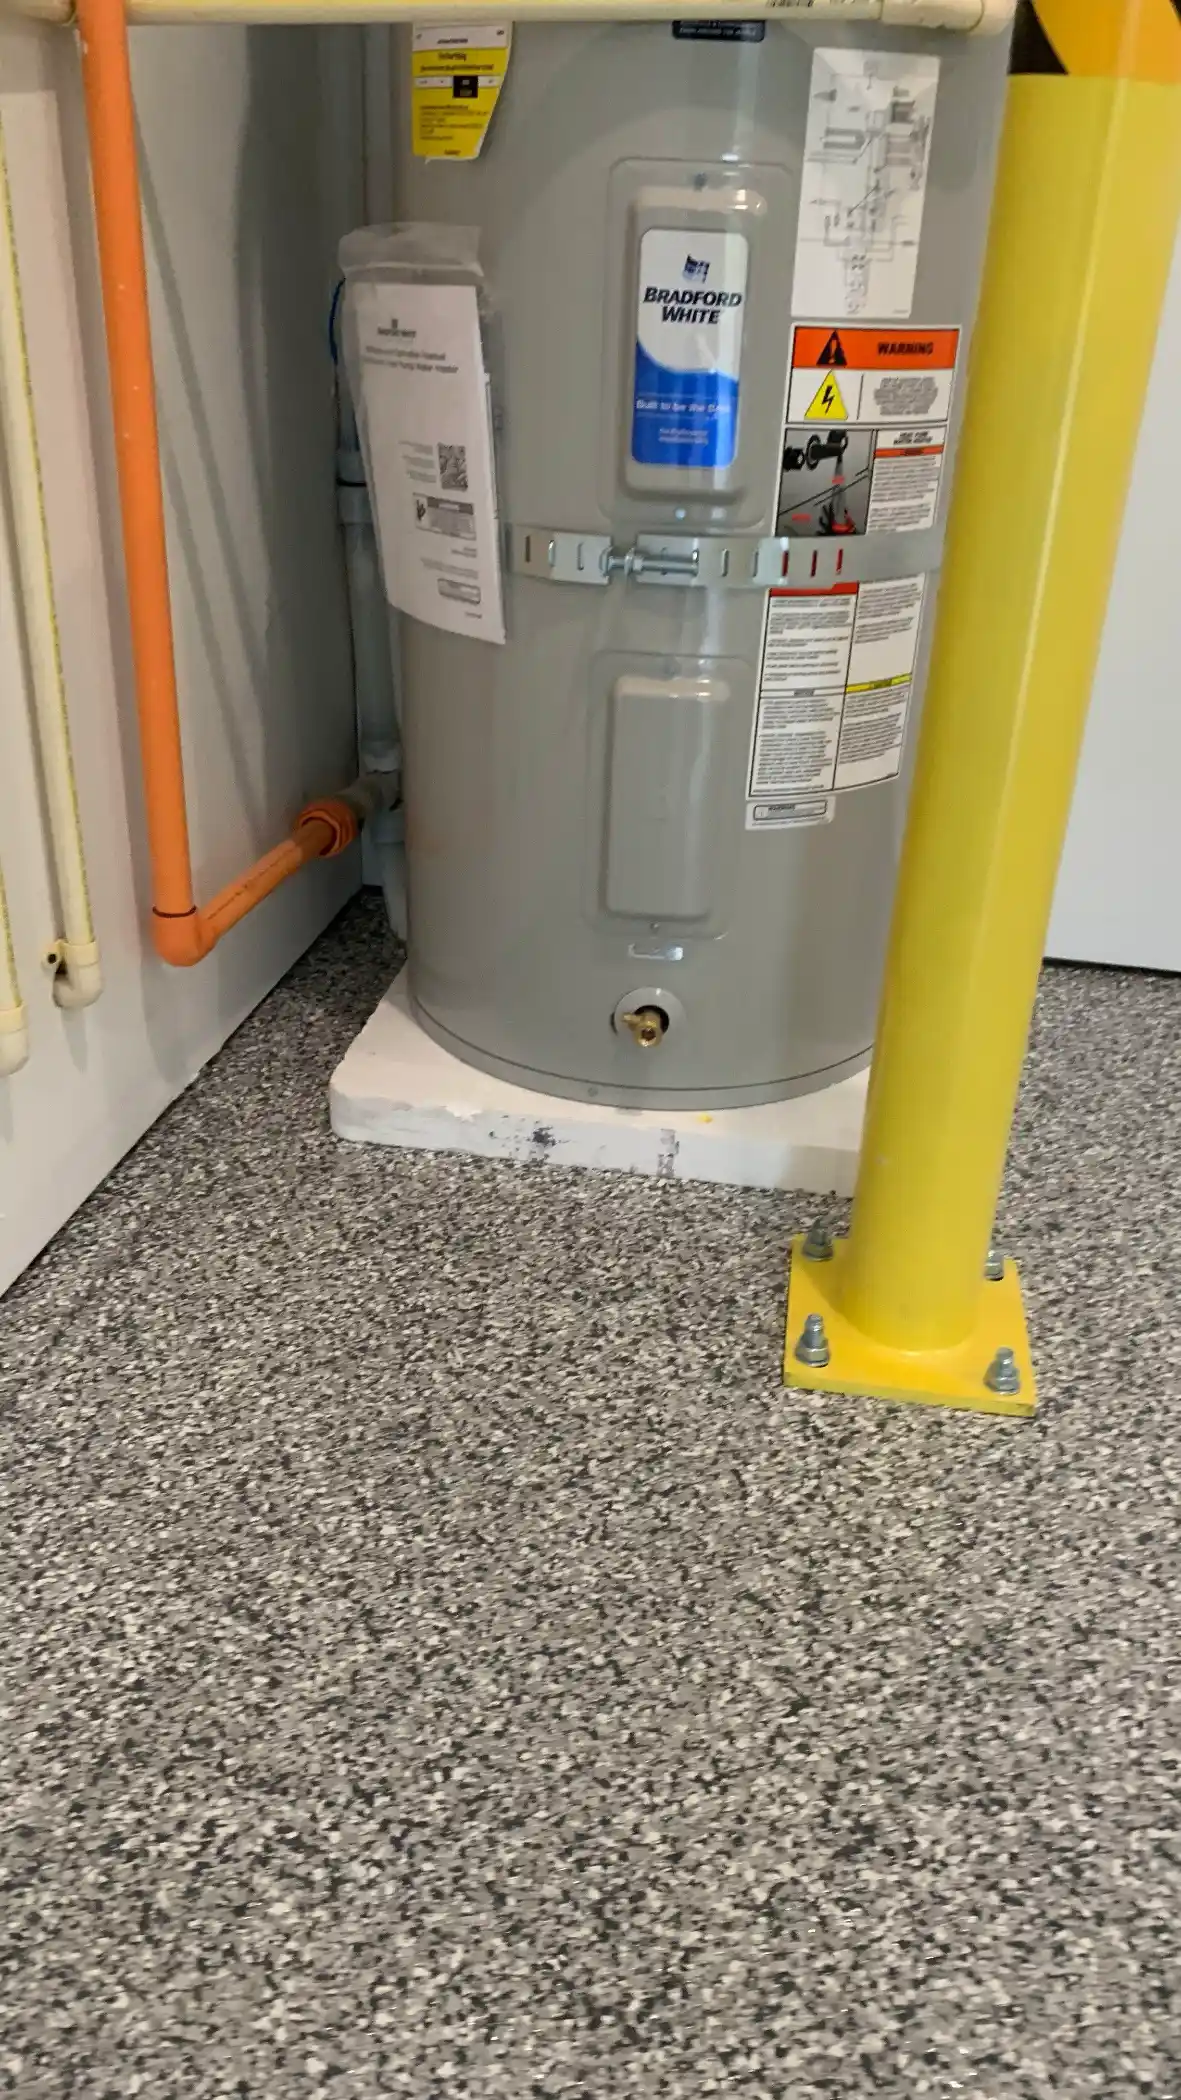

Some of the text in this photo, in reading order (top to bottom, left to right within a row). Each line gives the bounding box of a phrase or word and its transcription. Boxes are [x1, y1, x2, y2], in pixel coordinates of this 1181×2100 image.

[643, 286, 742, 306] BRADFORD
[662, 306, 720, 324] WHITE
[878, 341, 934, 355] WARNING
